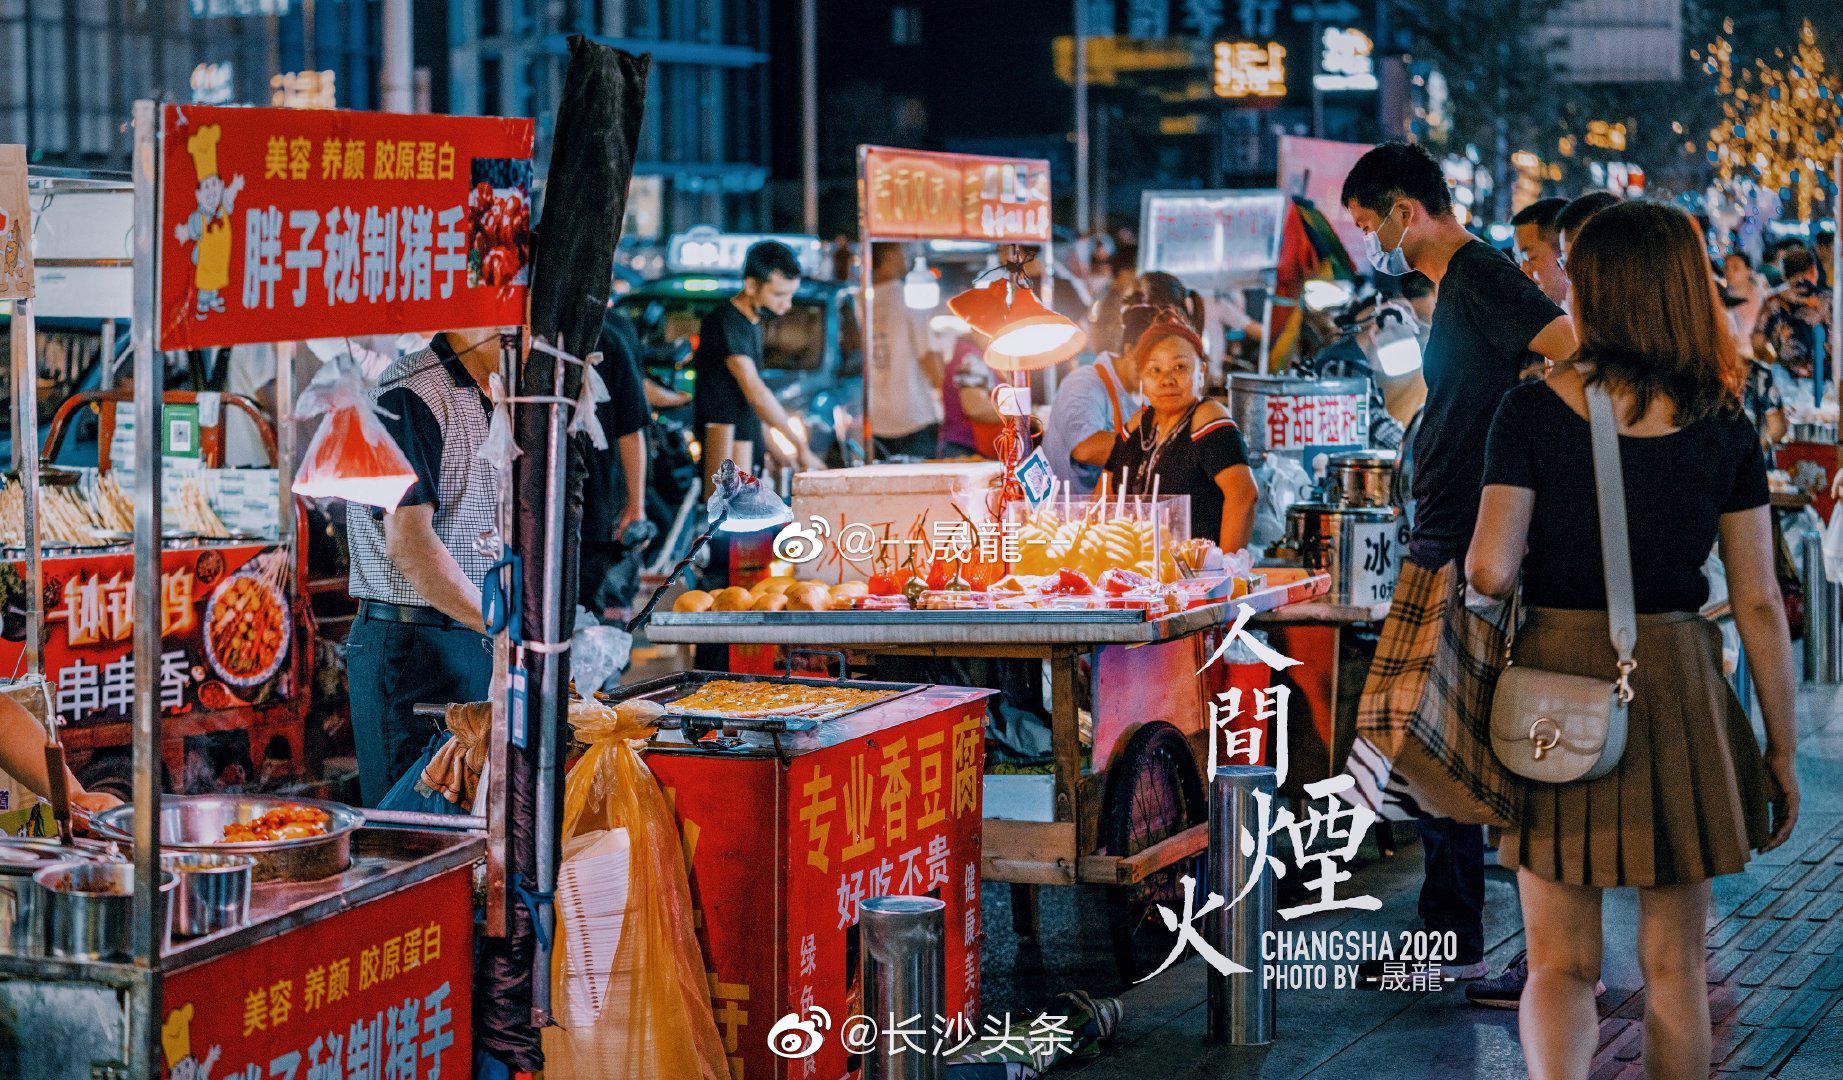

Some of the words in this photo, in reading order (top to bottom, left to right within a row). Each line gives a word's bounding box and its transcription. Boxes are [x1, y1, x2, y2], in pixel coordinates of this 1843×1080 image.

[265, 136, 311, 181] 美容
[322, 139, 365, 181] 养颜
[374, 140, 456, 182] 胶原蛋白
[241, 204, 467, 309] 胖子秘制猪手
[1364, 532, 1391, 576] 冰
[800, 714, 981, 875] 专业香豆腐
[837, 834, 951, 930] 好吃不贵
[243, 981, 293, 1038] 美容
[305, 958, 350, 1014] 养颜
[359, 921, 442, 991] 胶原蛋白
